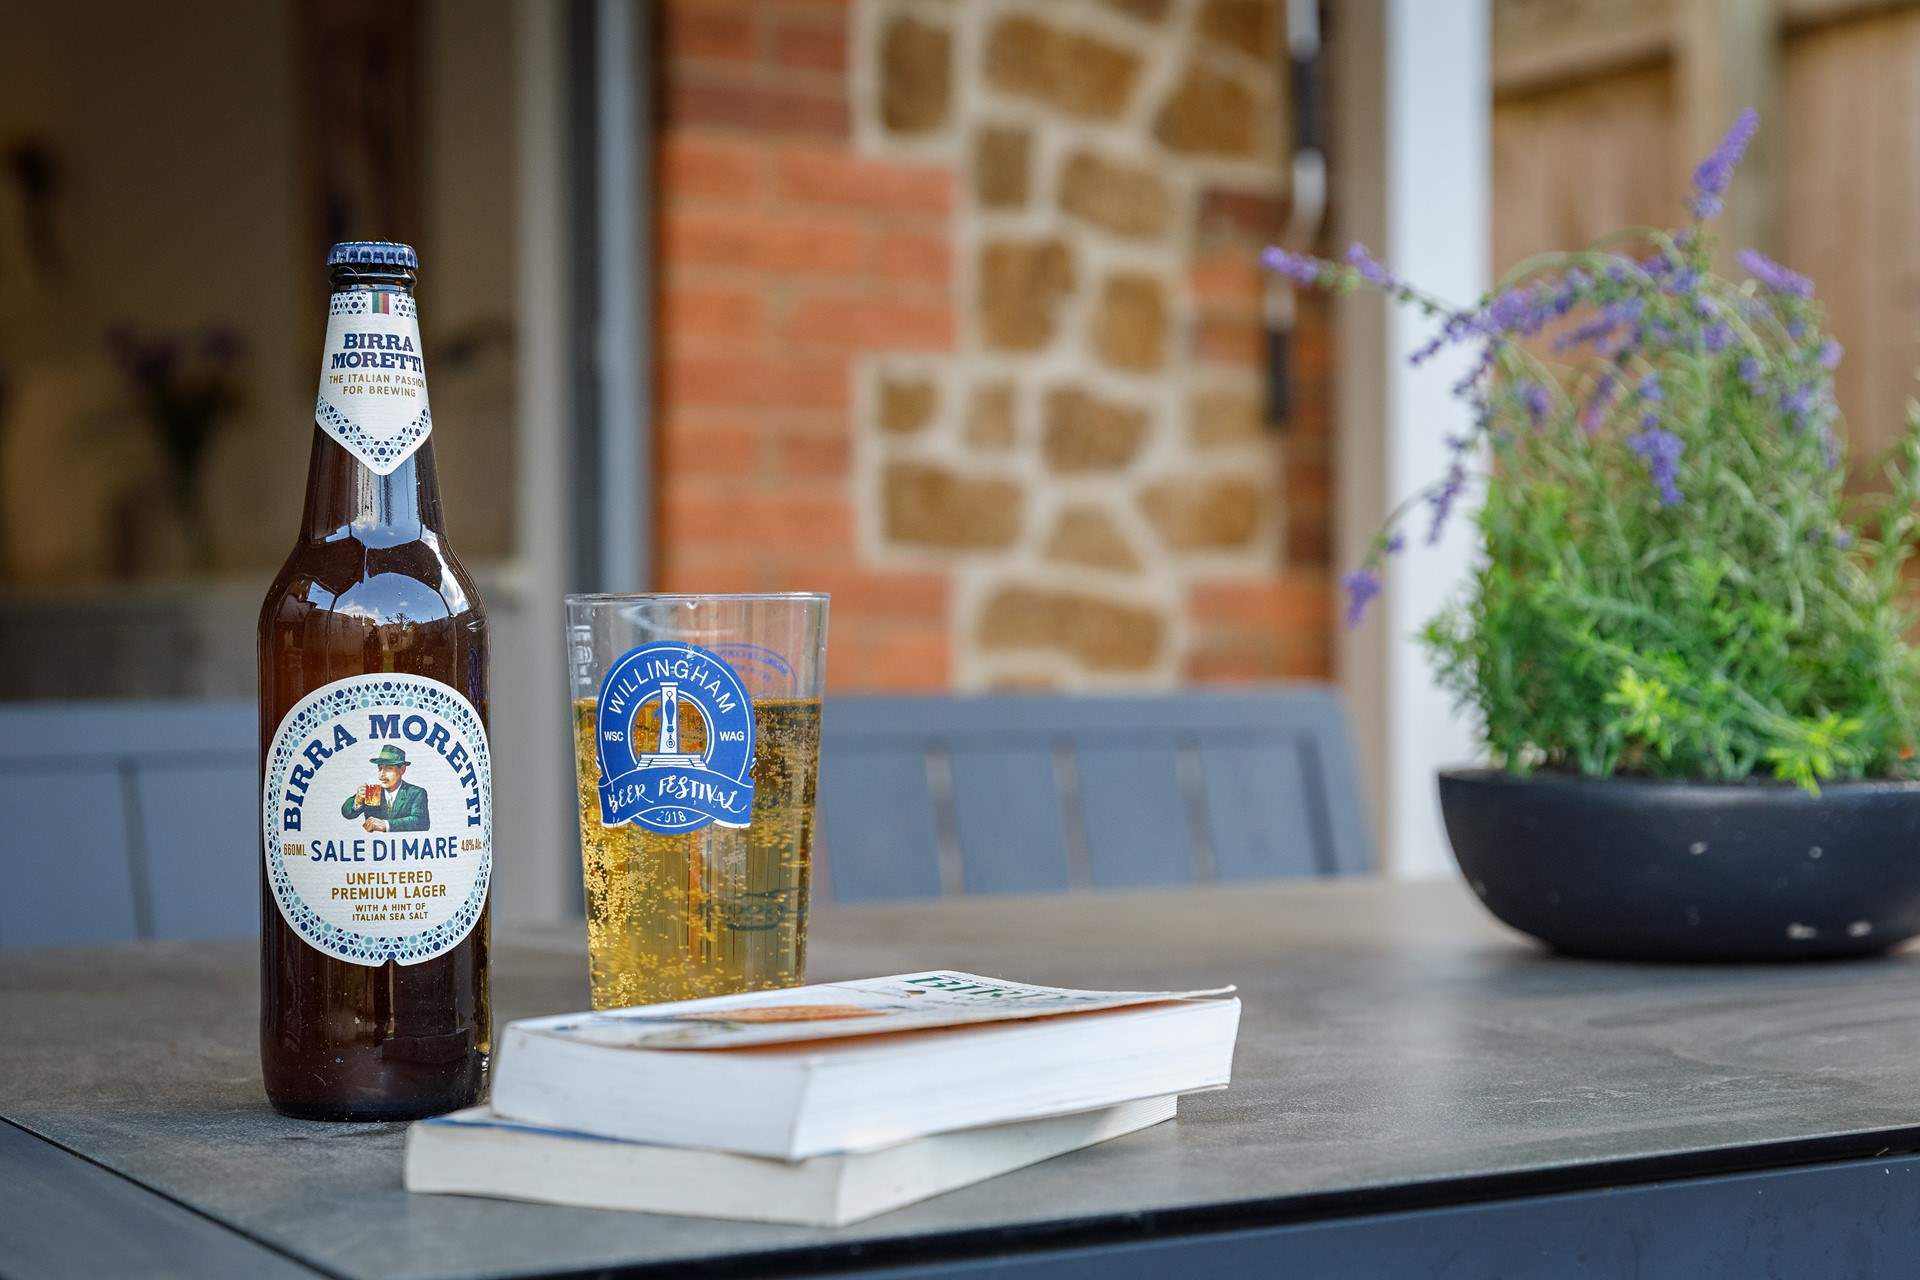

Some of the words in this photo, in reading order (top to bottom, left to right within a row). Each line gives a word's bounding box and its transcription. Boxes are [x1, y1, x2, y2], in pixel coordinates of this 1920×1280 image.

[343, 333, 414, 352] BIRRA
[331, 352, 423, 373] MORETTI
[329, 374, 344, 384] THE
[348, 373, 390, 383] ITALIAN
[395, 375, 425, 389] PASSION
[343, 386, 363, 395] FOR
[369, 385, 416, 398] BREWING
[608, 660, 736, 714] WILLINGHAM
[604, 731, 624, 742] WSC
[719, 731, 745, 742] WAG
[283, 723, 358, 832] BIRRA
[368, 714, 482, 828] MORETTI
[607, 784, 655, 814] BEER
[658, 775, 748, 814] FESTIVAL
[655, 810, 688, 823] 2018
[283, 843, 307, 857] 660ML
[310, 839, 366, 862] SALE
[372, 838, 397, 861] DI
[401, 836, 458, 860] MARE
[346, 870, 433, 885] UNFILTERED
[331, 886, 397, 900] PREMIUM
[403, 884, 446, 899] LAGER
[355, 904, 378, 913] WITH
[382, 904, 388, 912] A
[391, 903, 412, 912] HINT
[415, 902, 426, 911] OF
[352, 913, 386, 922] ITALIAN
[389, 913, 406, 922] SEA
[409, 911, 428, 920] SALT
